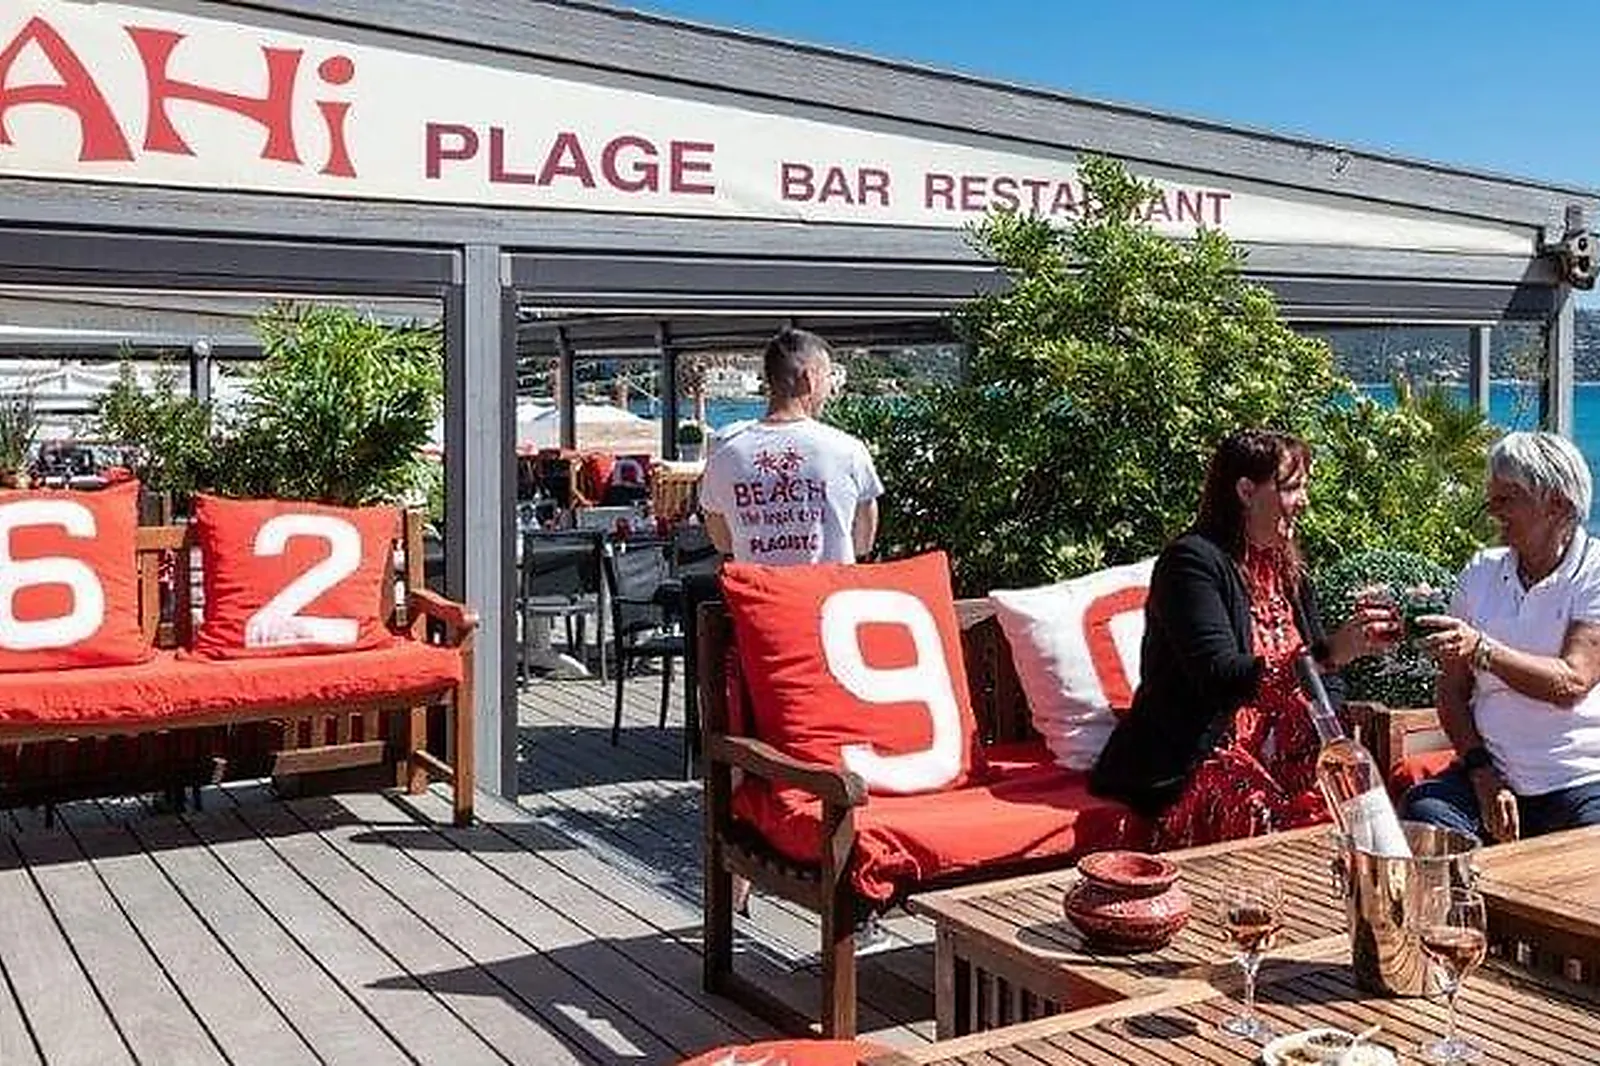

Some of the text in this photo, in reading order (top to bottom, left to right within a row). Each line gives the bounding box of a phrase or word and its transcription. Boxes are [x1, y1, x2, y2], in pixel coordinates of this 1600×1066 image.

[0, 17, 1232, 225] AHi PLAGE BAR RESTAANT
[734, 479, 826, 507] BEACH
[0, 500, 104, 652] 6
[244, 513, 363, 649] 2
[820, 588, 963, 793] 9
